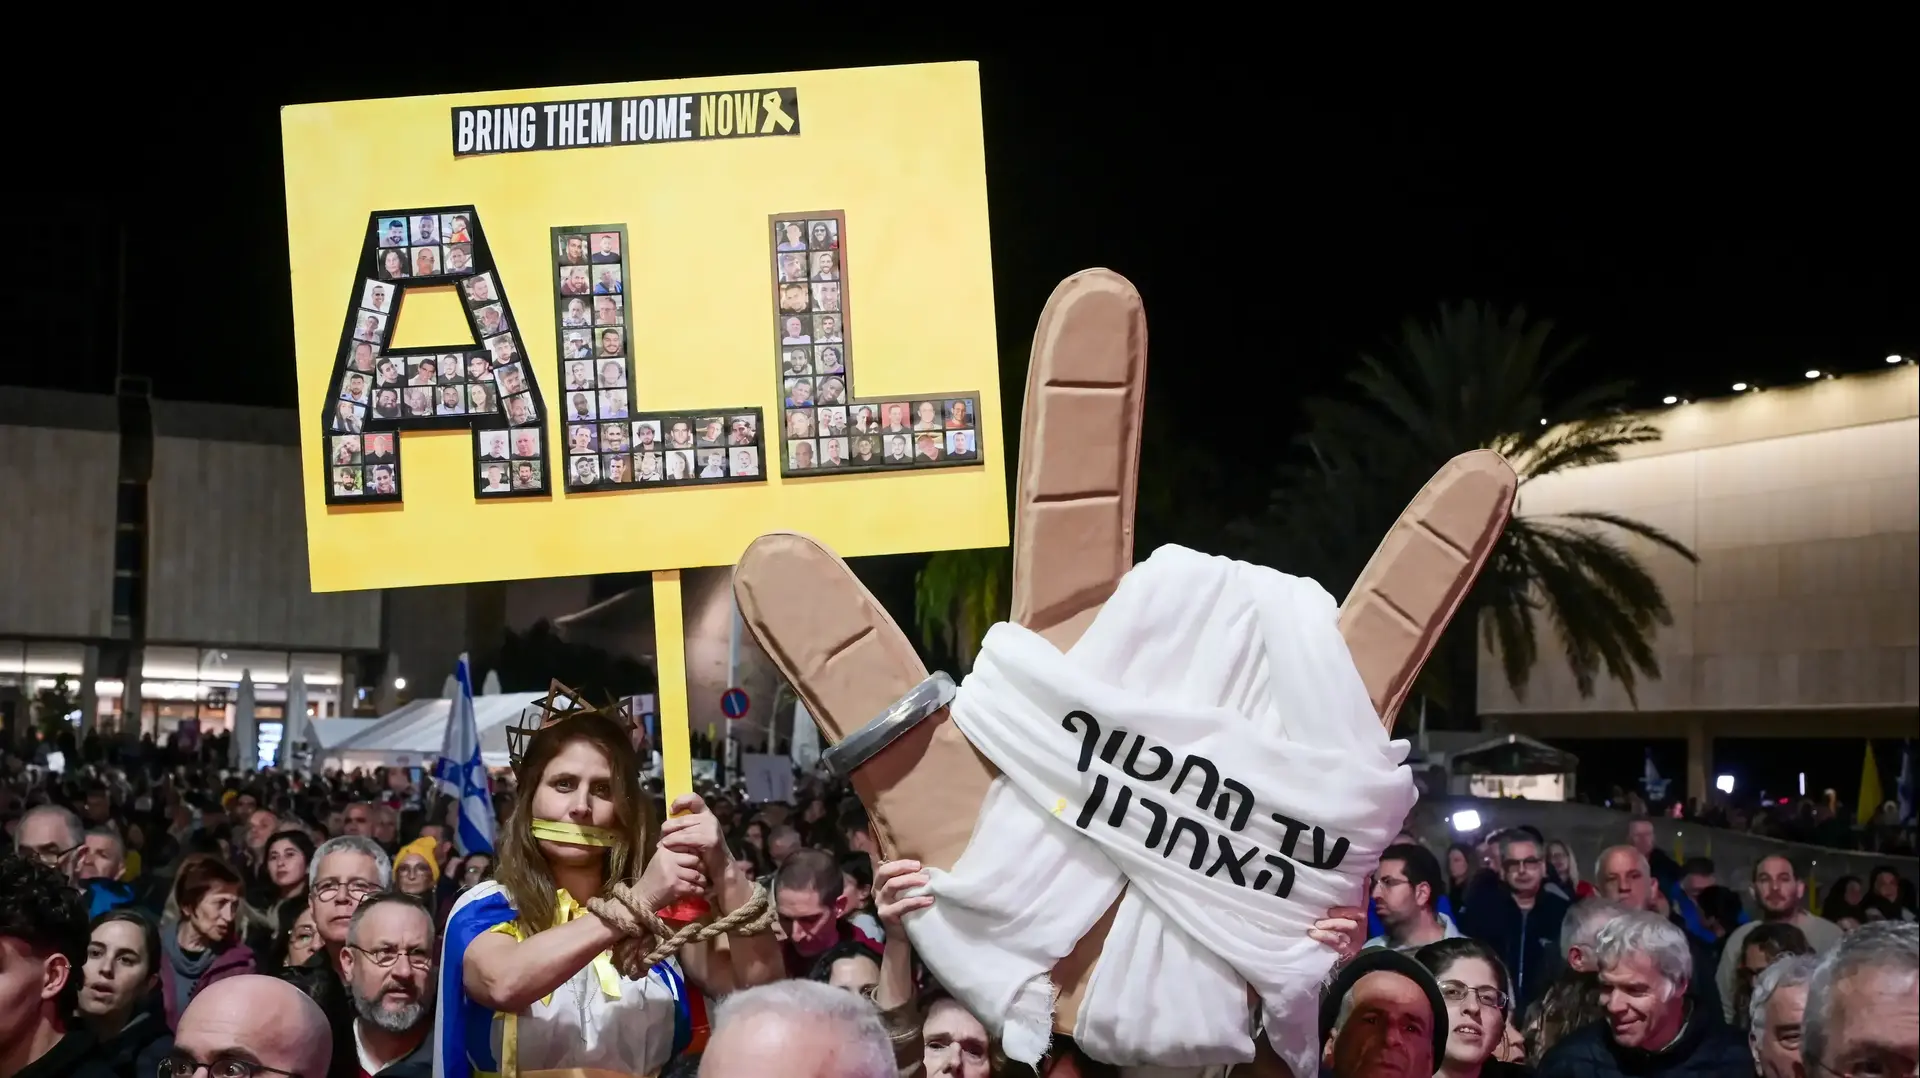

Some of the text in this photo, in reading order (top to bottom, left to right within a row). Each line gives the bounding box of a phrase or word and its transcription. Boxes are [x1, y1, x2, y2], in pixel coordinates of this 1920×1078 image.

[458, 92, 760, 152] BRING THEM HOME NOW
[322, 204, 984, 504] ALL
[1061, 709, 1350, 870] עד החטוף
[1076, 773, 1296, 899] האחרון
